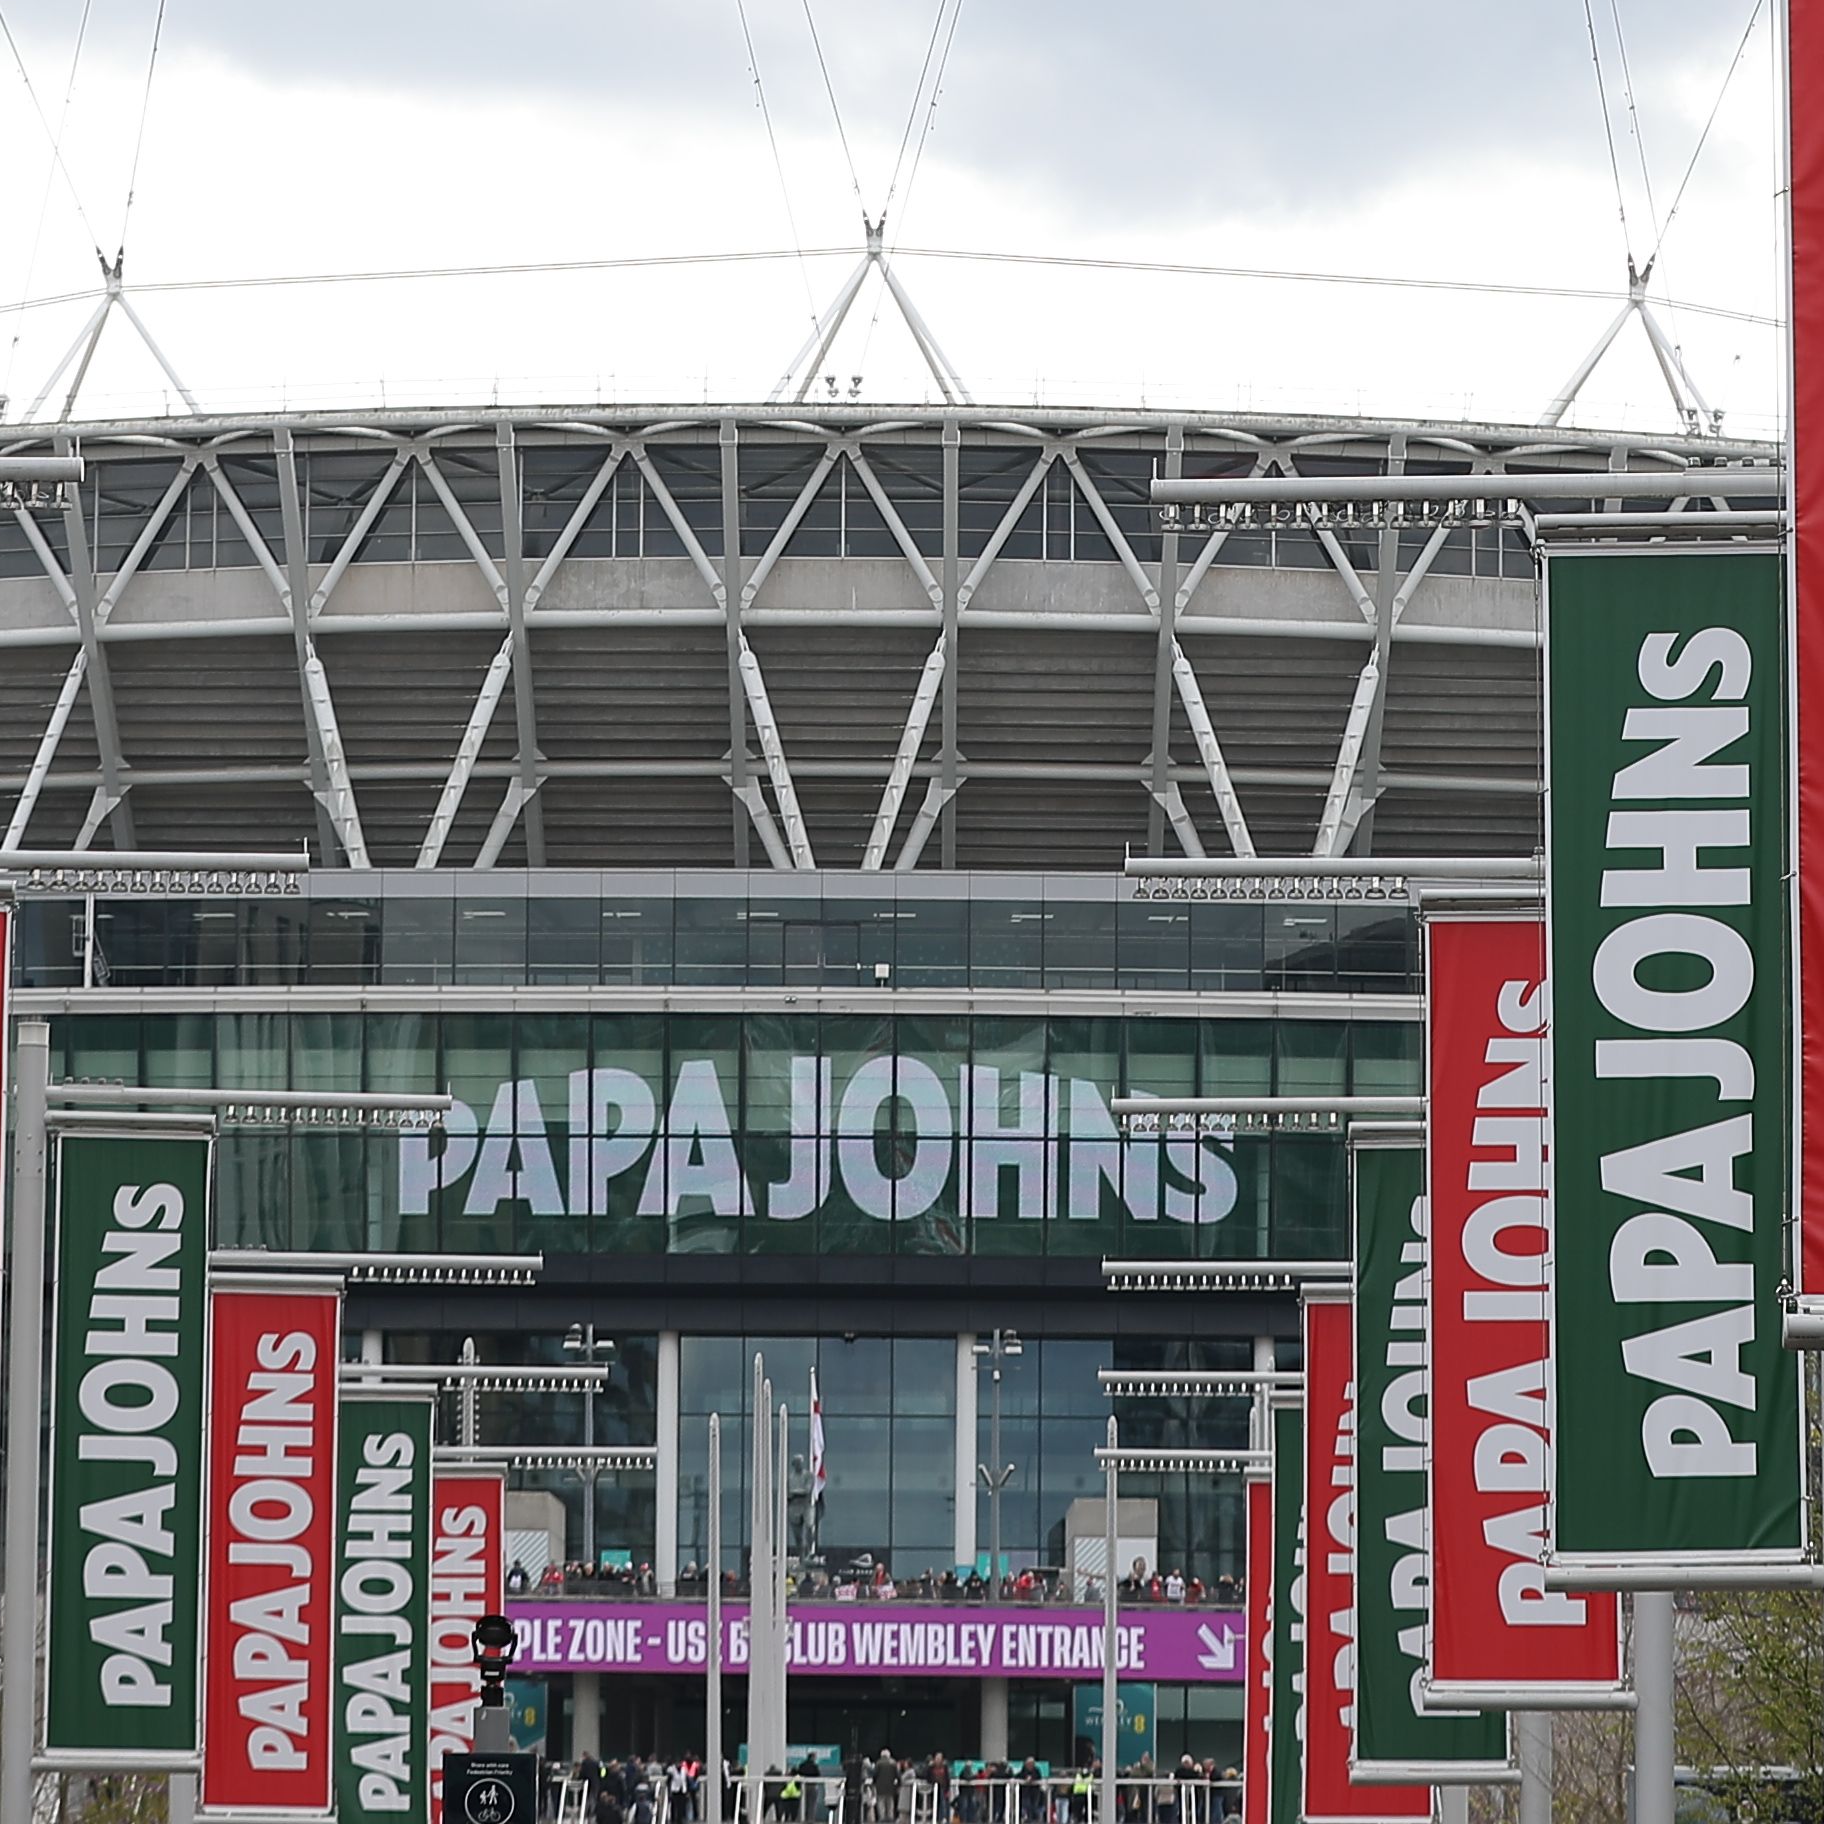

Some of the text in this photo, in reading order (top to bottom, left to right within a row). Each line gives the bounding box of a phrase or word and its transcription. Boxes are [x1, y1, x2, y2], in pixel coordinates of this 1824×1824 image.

[512, 1618, 564, 1662] PLE
[568, 1618, 642, 1663] ZONE
[666, 1619, 723, 1665] US
[852, 1622, 996, 1667] WEMBLEY
[1002, 1624, 1145, 1670] ENTRANCE
